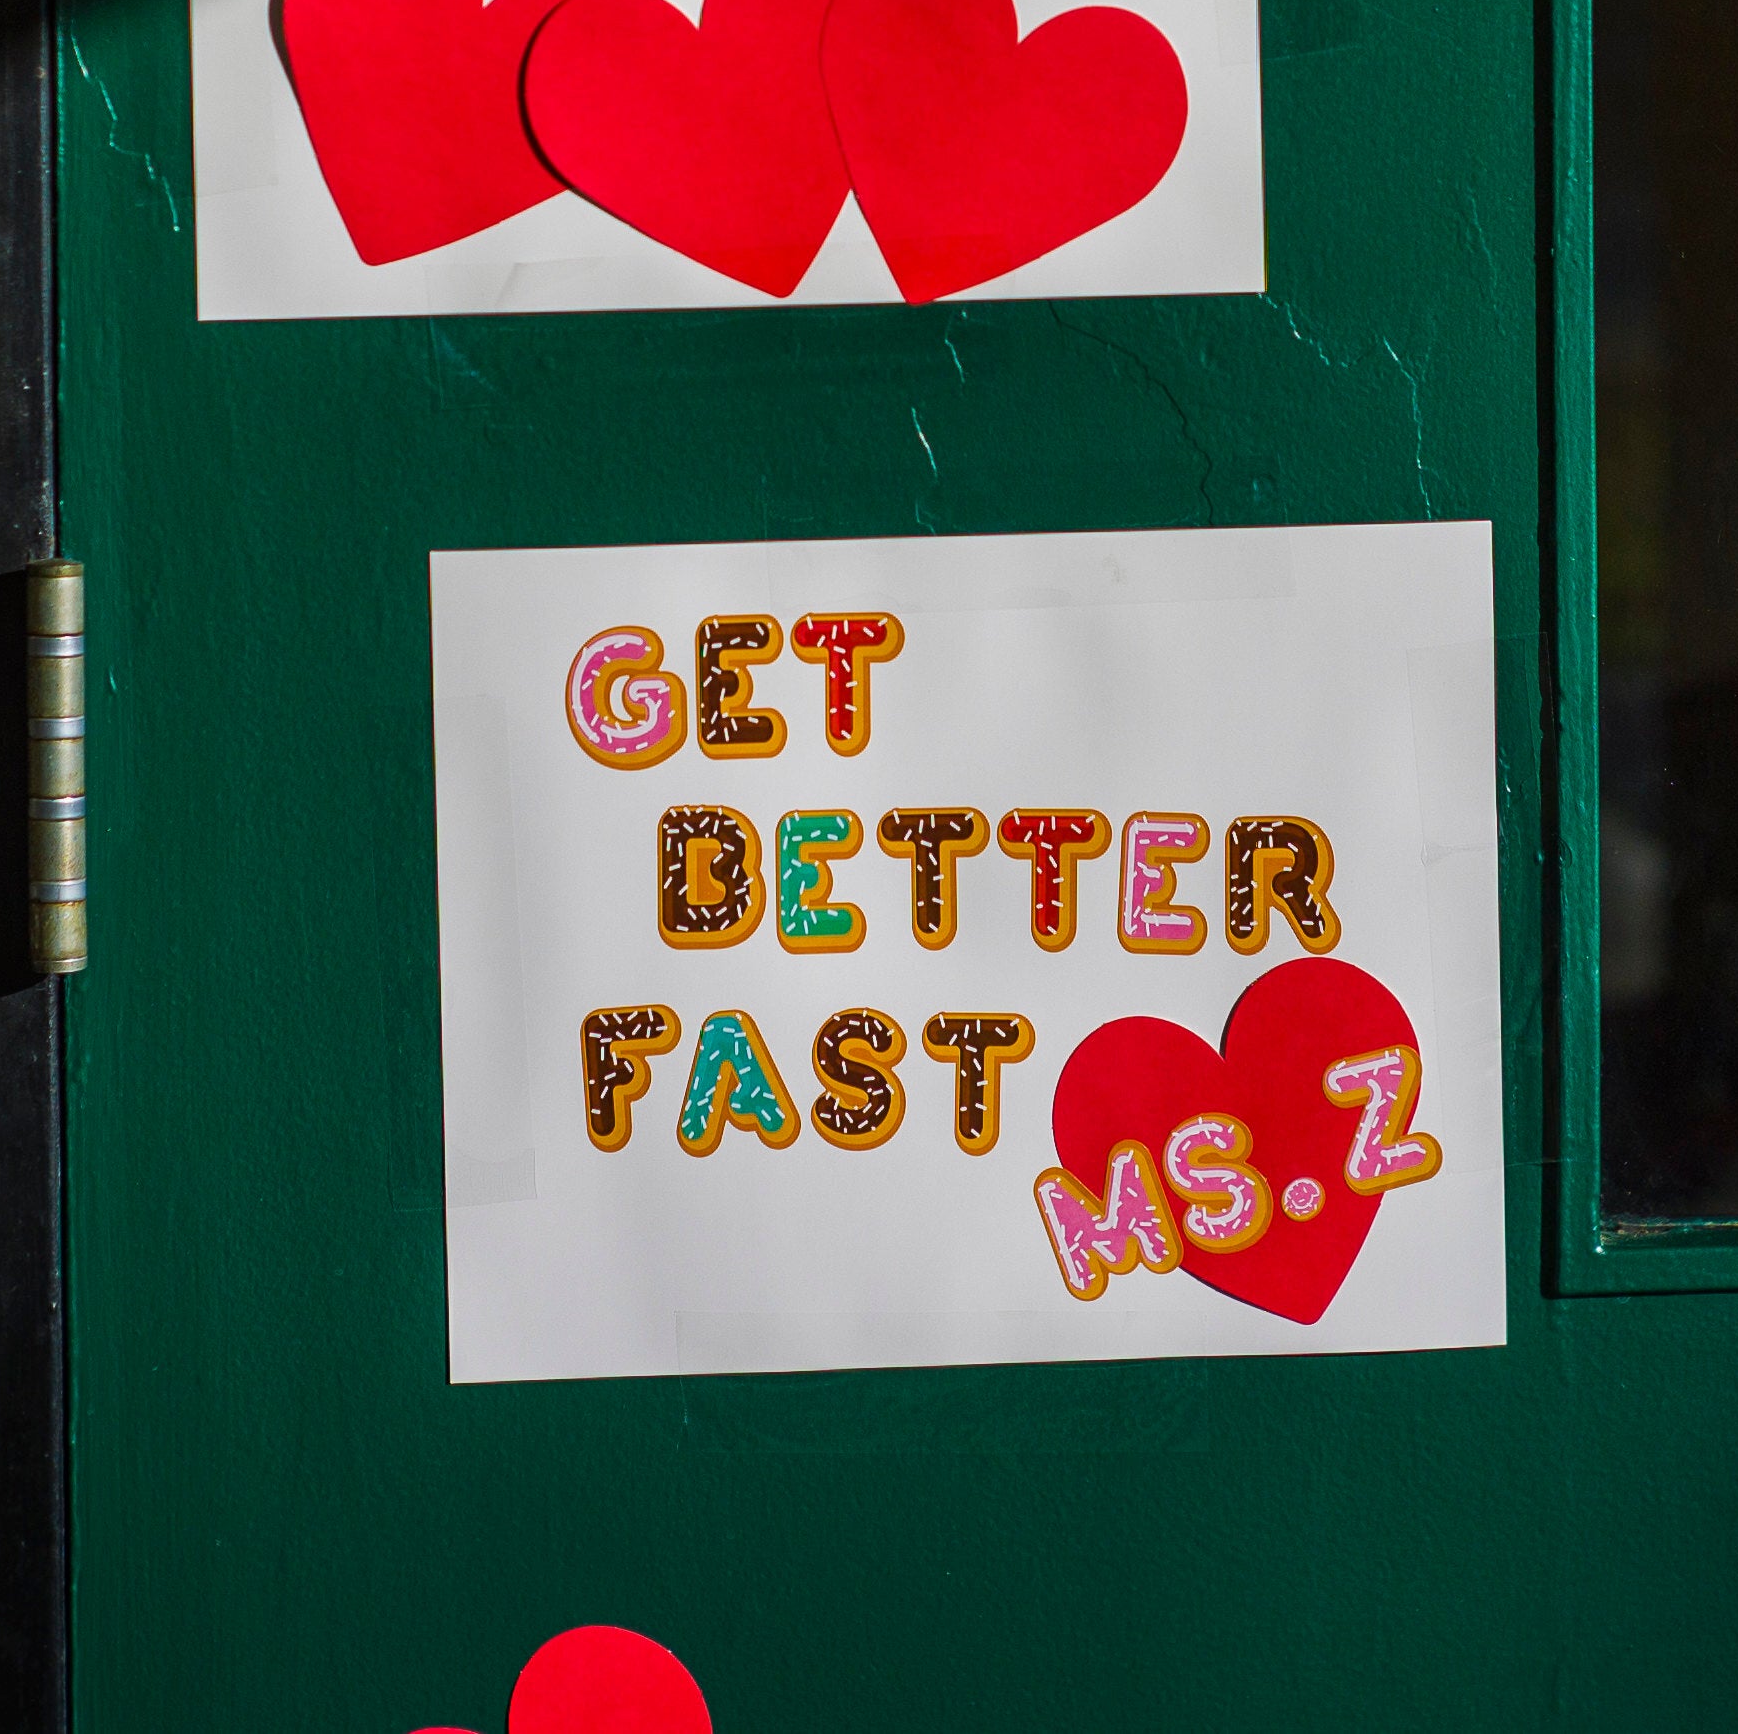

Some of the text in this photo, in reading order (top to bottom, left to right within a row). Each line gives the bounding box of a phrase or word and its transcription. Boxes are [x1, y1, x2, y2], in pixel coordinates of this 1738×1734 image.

[565, 612, 905, 771] GET
[657, 805, 1341, 956] BETTER
[580, 1004, 1036, 1157] FAST
[1033, 1043, 1443, 1300] MS. Z
